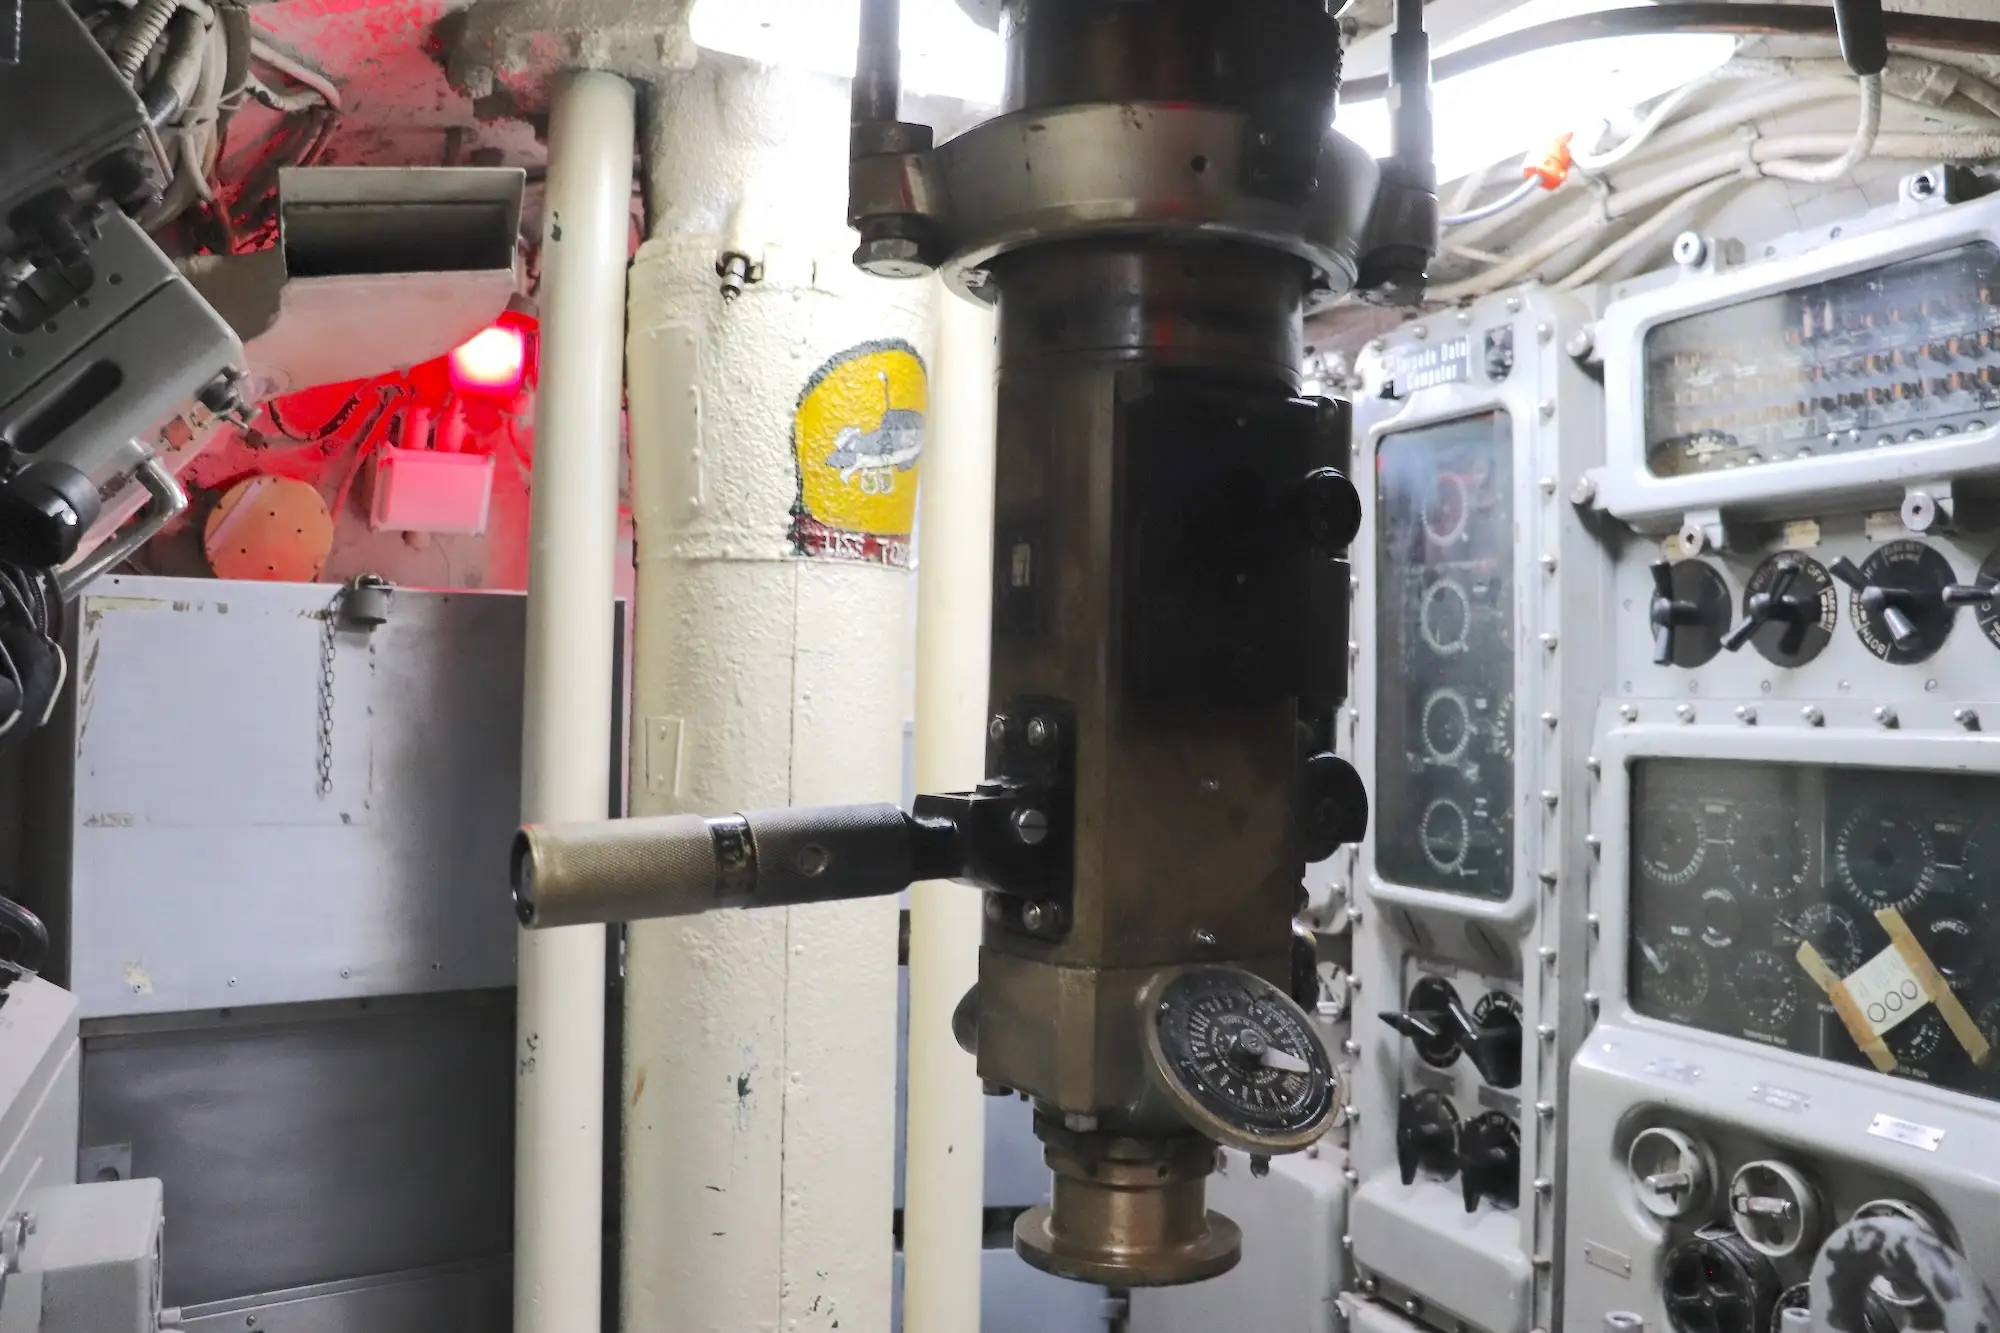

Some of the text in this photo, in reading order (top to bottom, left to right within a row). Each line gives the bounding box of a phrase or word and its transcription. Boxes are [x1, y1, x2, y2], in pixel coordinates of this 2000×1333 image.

[1396, 341, 1466, 373] Torpedo Data
[1406, 363, 1457, 390] Computer
[1861, 627, 1887, 655] BOTH
